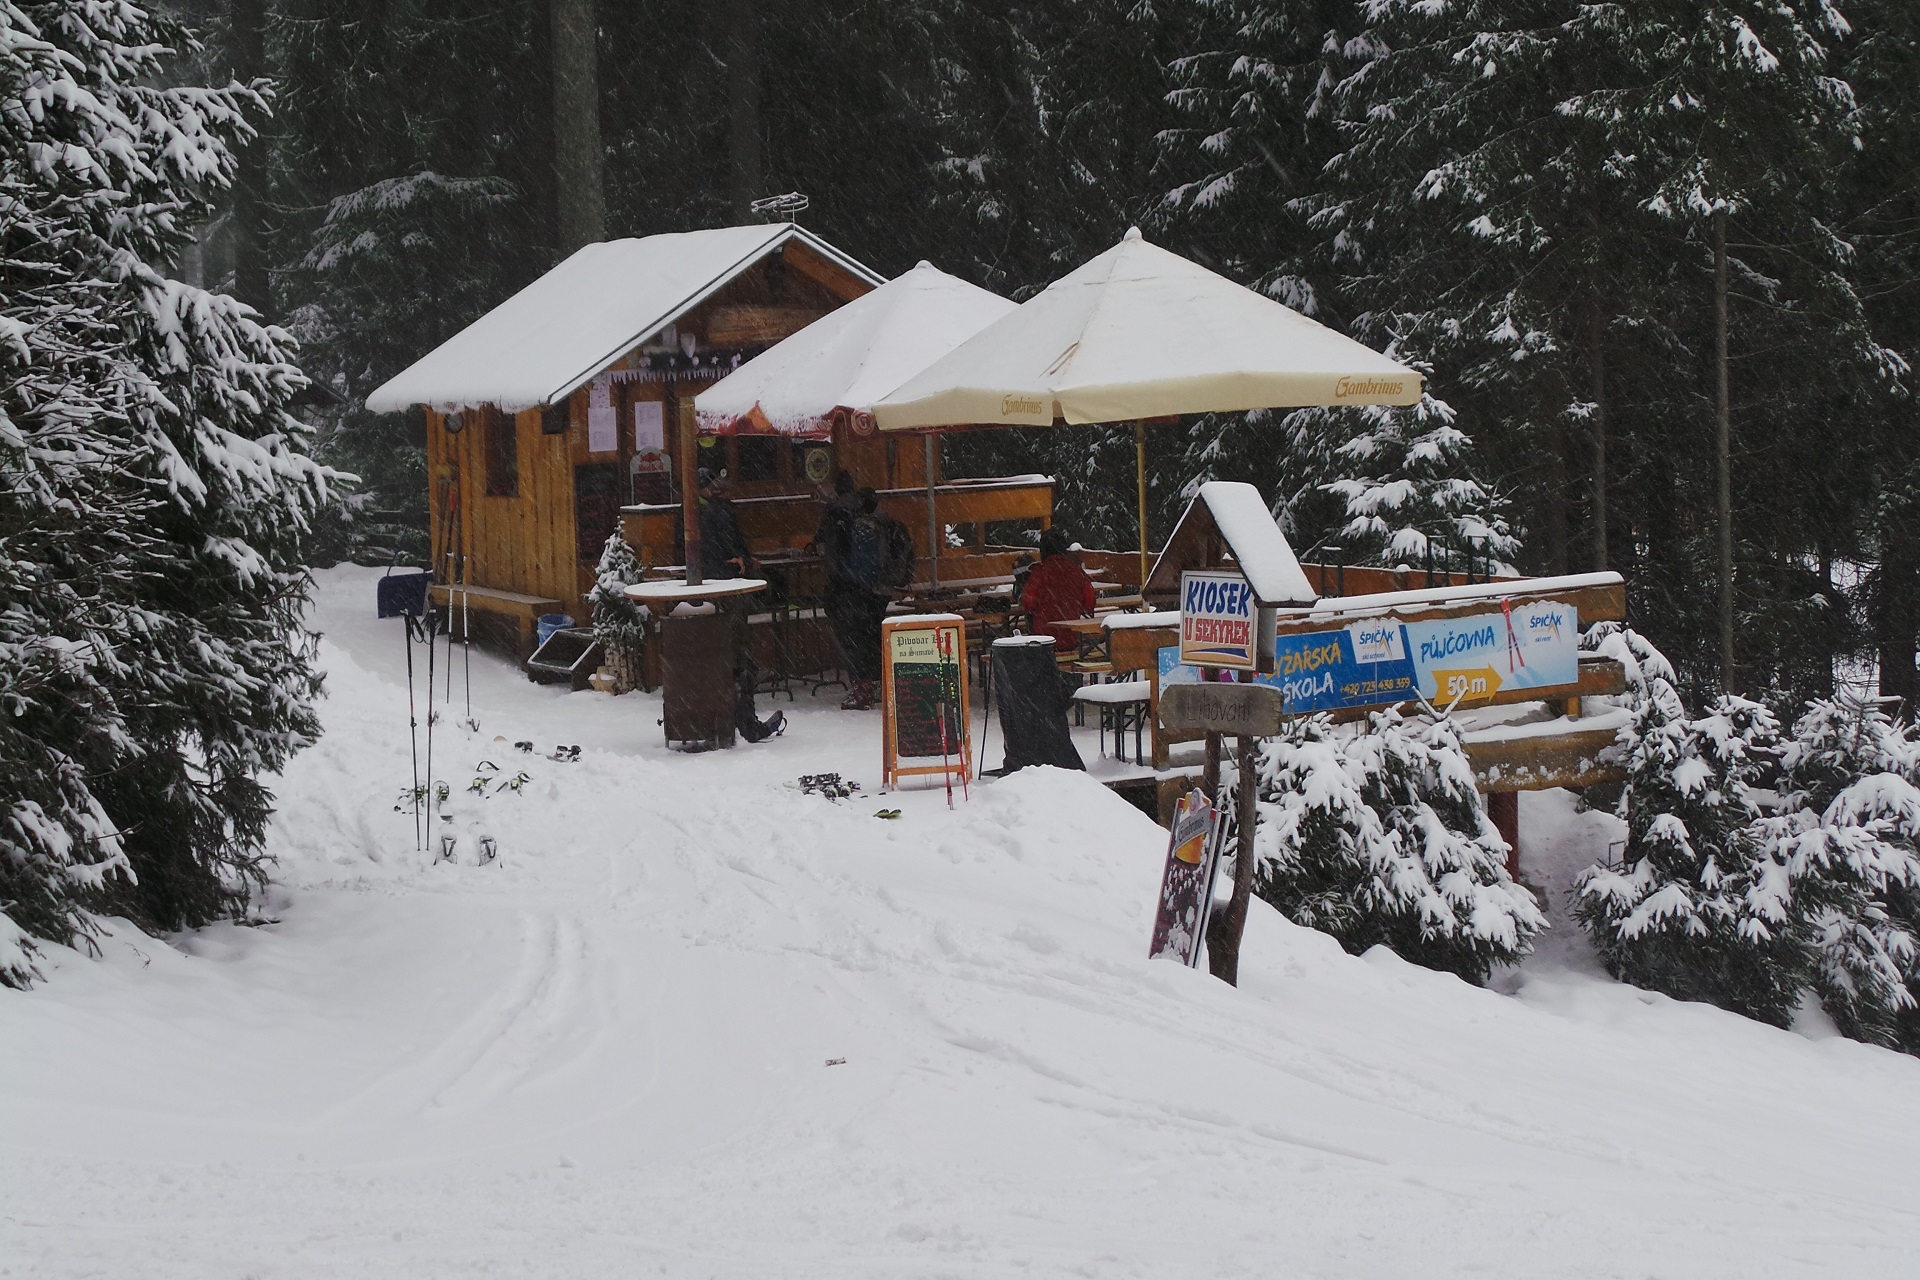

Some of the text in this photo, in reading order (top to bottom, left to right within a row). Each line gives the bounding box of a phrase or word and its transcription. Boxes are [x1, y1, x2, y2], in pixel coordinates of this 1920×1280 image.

[1335, 375, 1404, 398] Gambrinus
[1001, 393, 1042, 416] Gambrinus
[1185, 580, 1252, 618] KIOSEK
[897, 636, 929, 647] Pivovar
[1184, 617, 1251, 646] U SEKYREK
[1421, 625, 1495, 663] PŮJČOVNA
[1264, 637, 1342, 679] YŽAŘSKÁ
[1282, 671, 1334, 704] ŠKOLA
[1341, 677, 1411, 694] +420 723 438 359
[1447, 675, 1487, 697] 50 m
